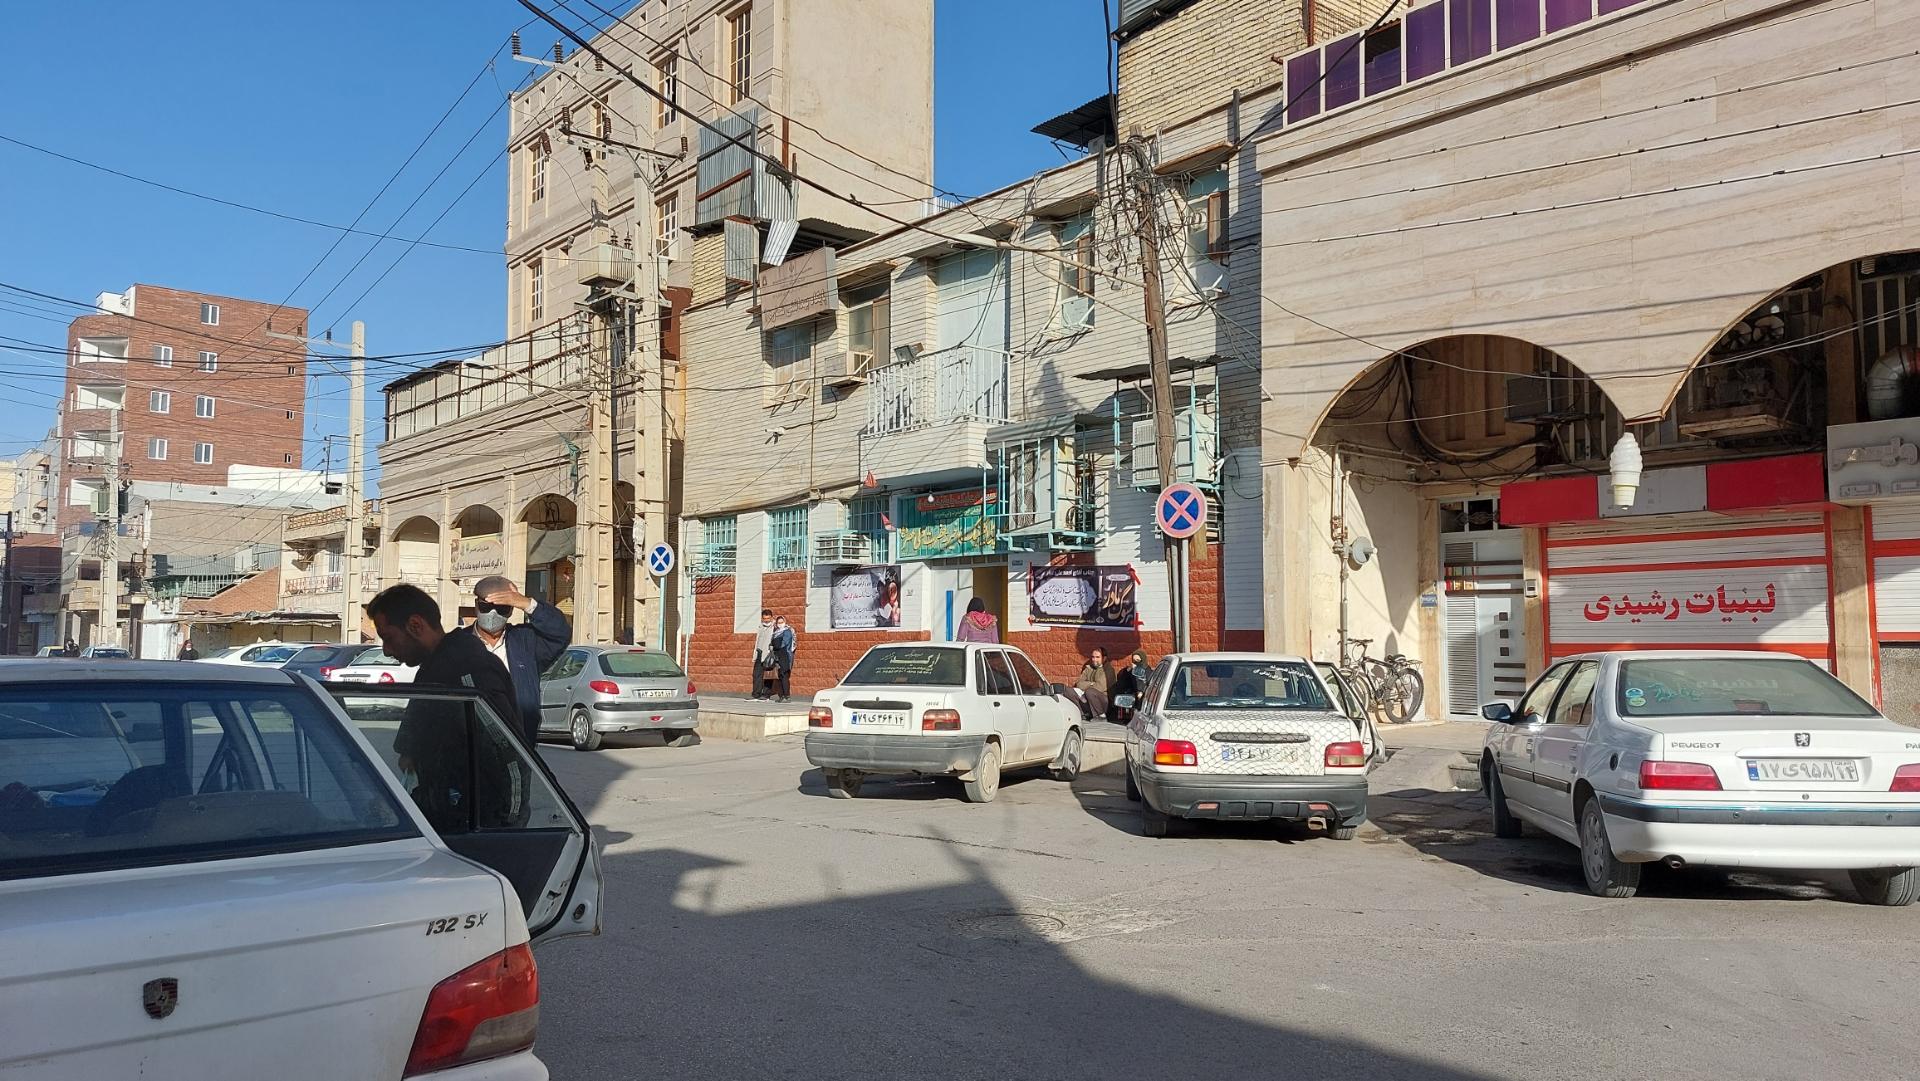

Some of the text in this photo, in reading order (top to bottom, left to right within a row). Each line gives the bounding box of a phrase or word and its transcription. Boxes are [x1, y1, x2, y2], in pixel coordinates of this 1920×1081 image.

[1583, 583, 1776, 624] لبنیات رشیدی
[1671, 741, 1721, 749] PEUGEOT
[1905, 742, 1920, 750] PA
[425, 912, 489, 936] 132 SX
